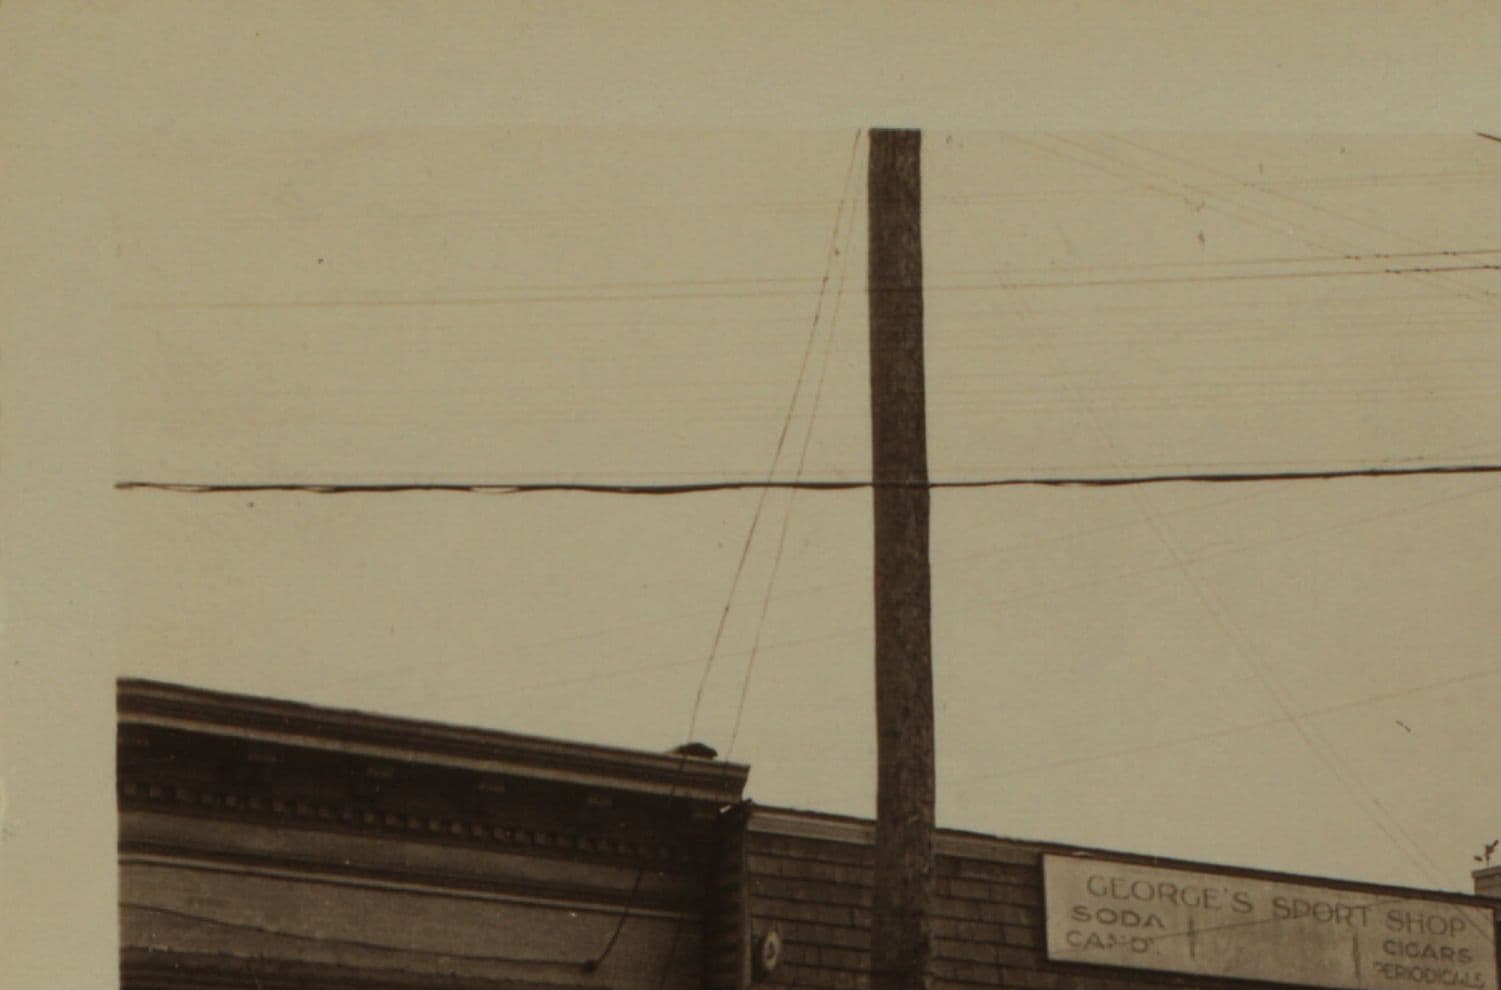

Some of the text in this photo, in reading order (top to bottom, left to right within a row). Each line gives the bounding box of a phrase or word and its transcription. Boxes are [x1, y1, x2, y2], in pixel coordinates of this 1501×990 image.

[1071, 904, 1166, 929] SODA
[1086, 874, 1467, 938] GEORGE'S SPORT SHOP
[1382, 939, 1474, 964] CIGARS
